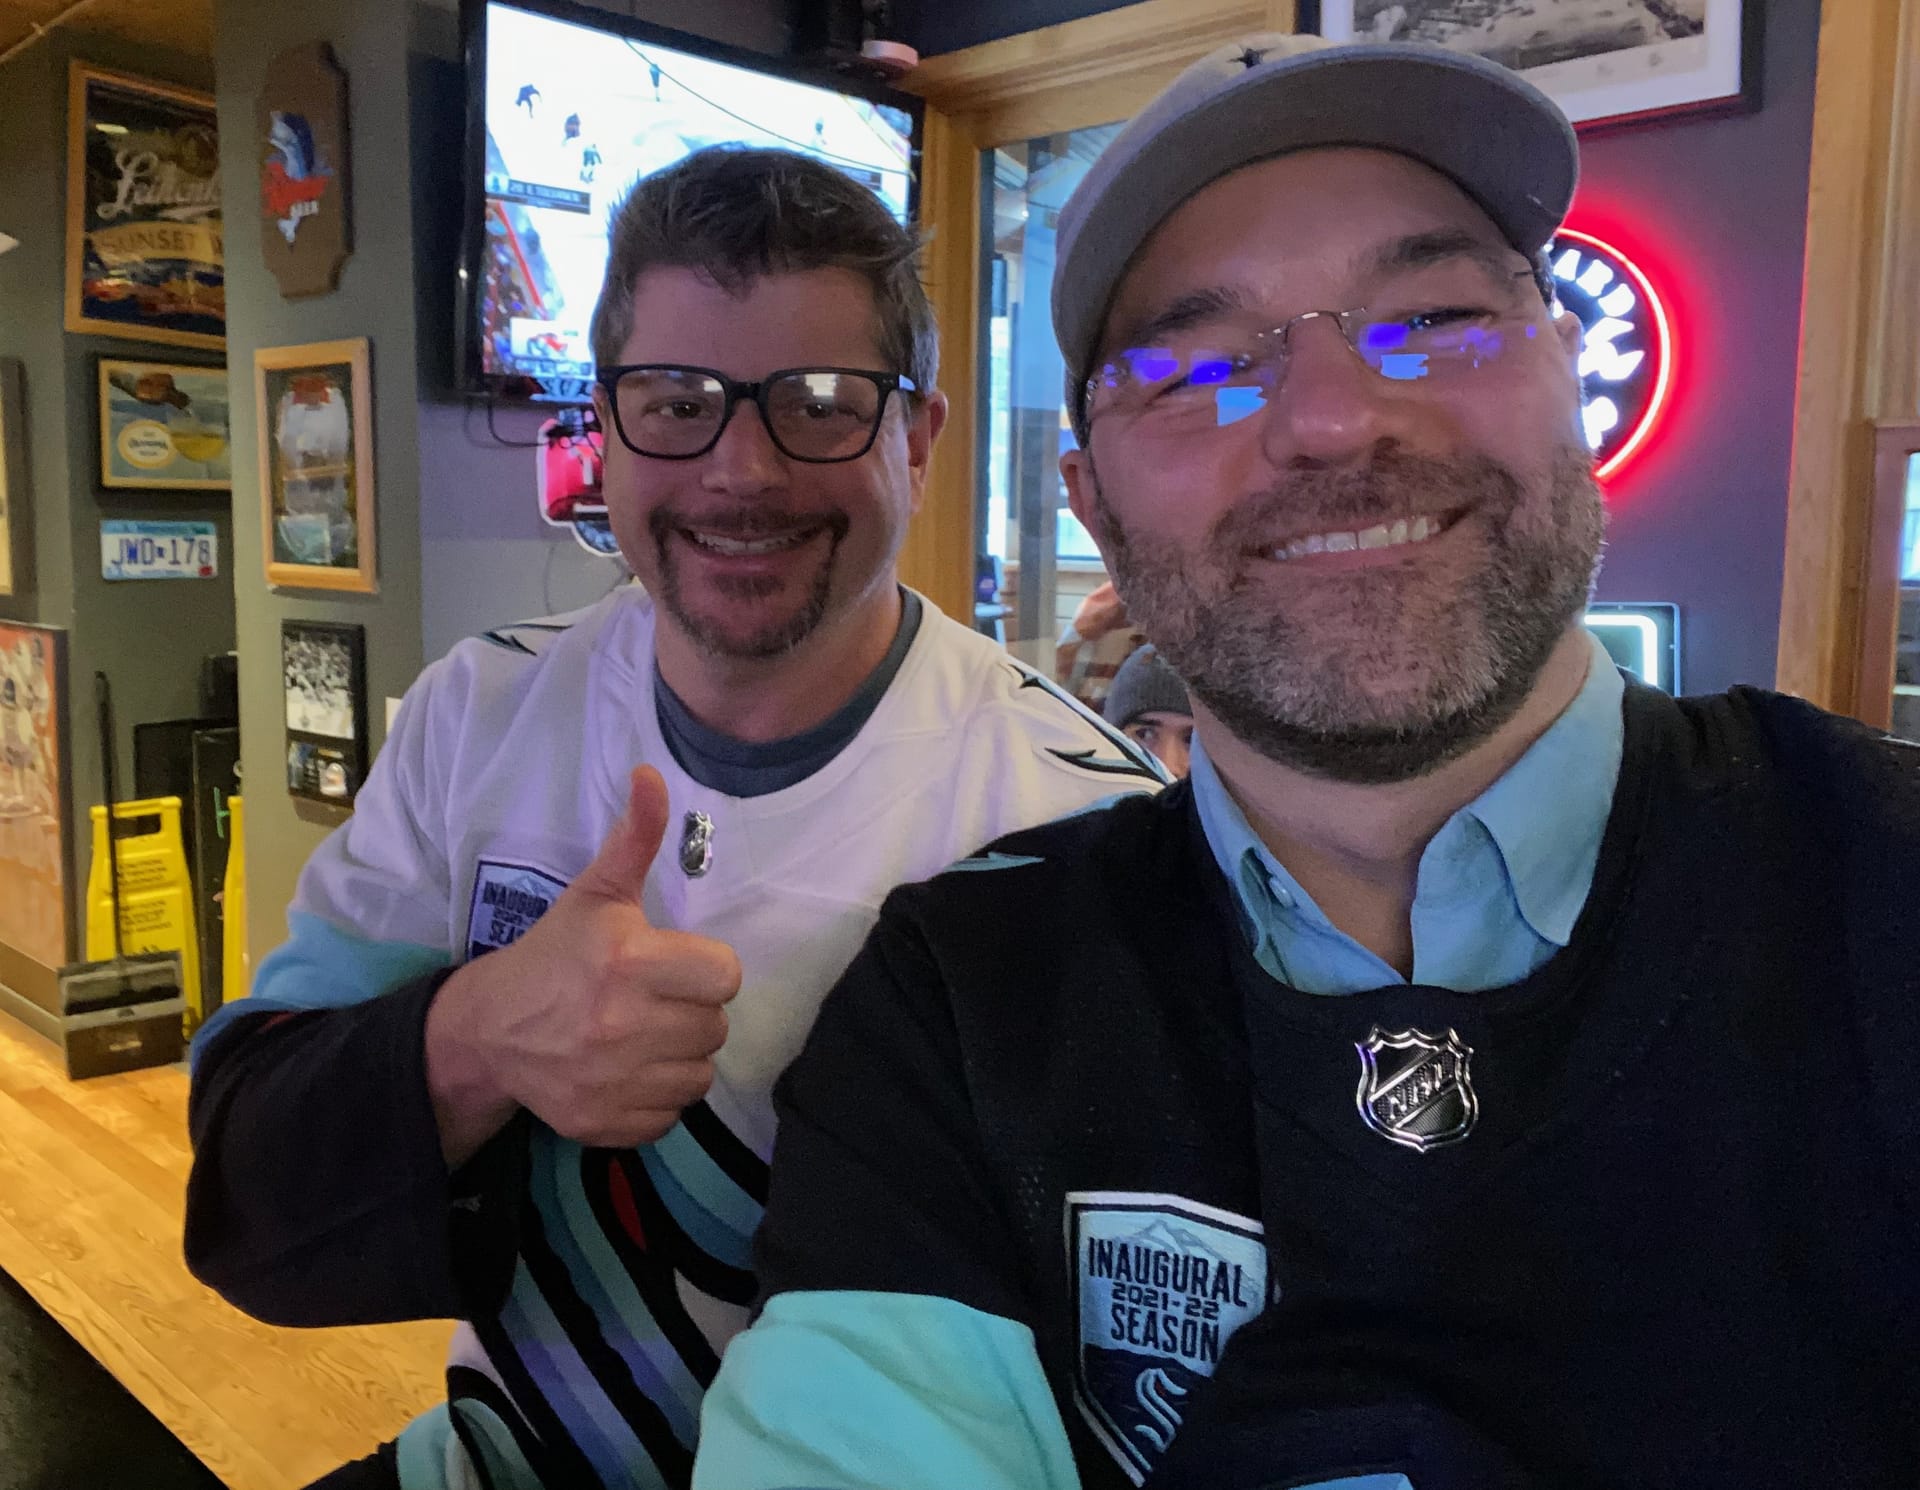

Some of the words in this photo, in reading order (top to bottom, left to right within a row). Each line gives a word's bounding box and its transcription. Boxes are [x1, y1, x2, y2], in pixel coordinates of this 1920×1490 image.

[1088, 1237, 1249, 1308] INAUGURAL
[1111, 1281, 1221, 1321] 2021-22
[1110, 1303, 1220, 1363] SEASON
